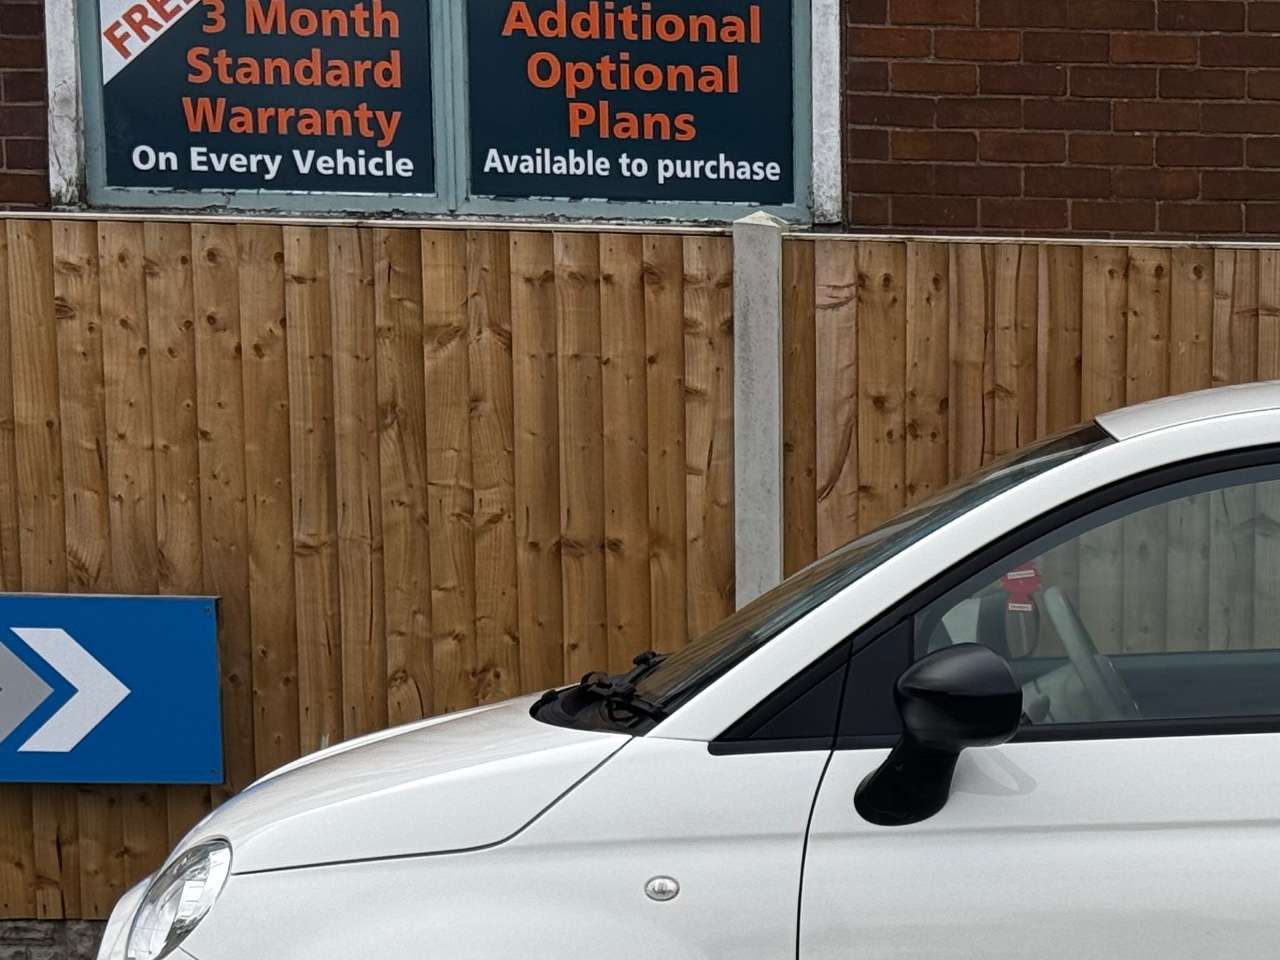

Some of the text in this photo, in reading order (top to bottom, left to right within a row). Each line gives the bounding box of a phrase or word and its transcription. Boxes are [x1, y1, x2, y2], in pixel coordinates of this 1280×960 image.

[103, 0, 193, 60] FRE
[203, 0, 399, 36] 3 Month
[503, 1, 760, 43] Additional
[187, 47, 401, 87] Standard
[527, 51, 738, 97] Optional
[183, 97, 400, 146] Warranty
[569, 101, 695, 141] Plans
[132, 145, 414, 180] On Every Vehicle
[483, 148, 781, 184] Available to purchase
